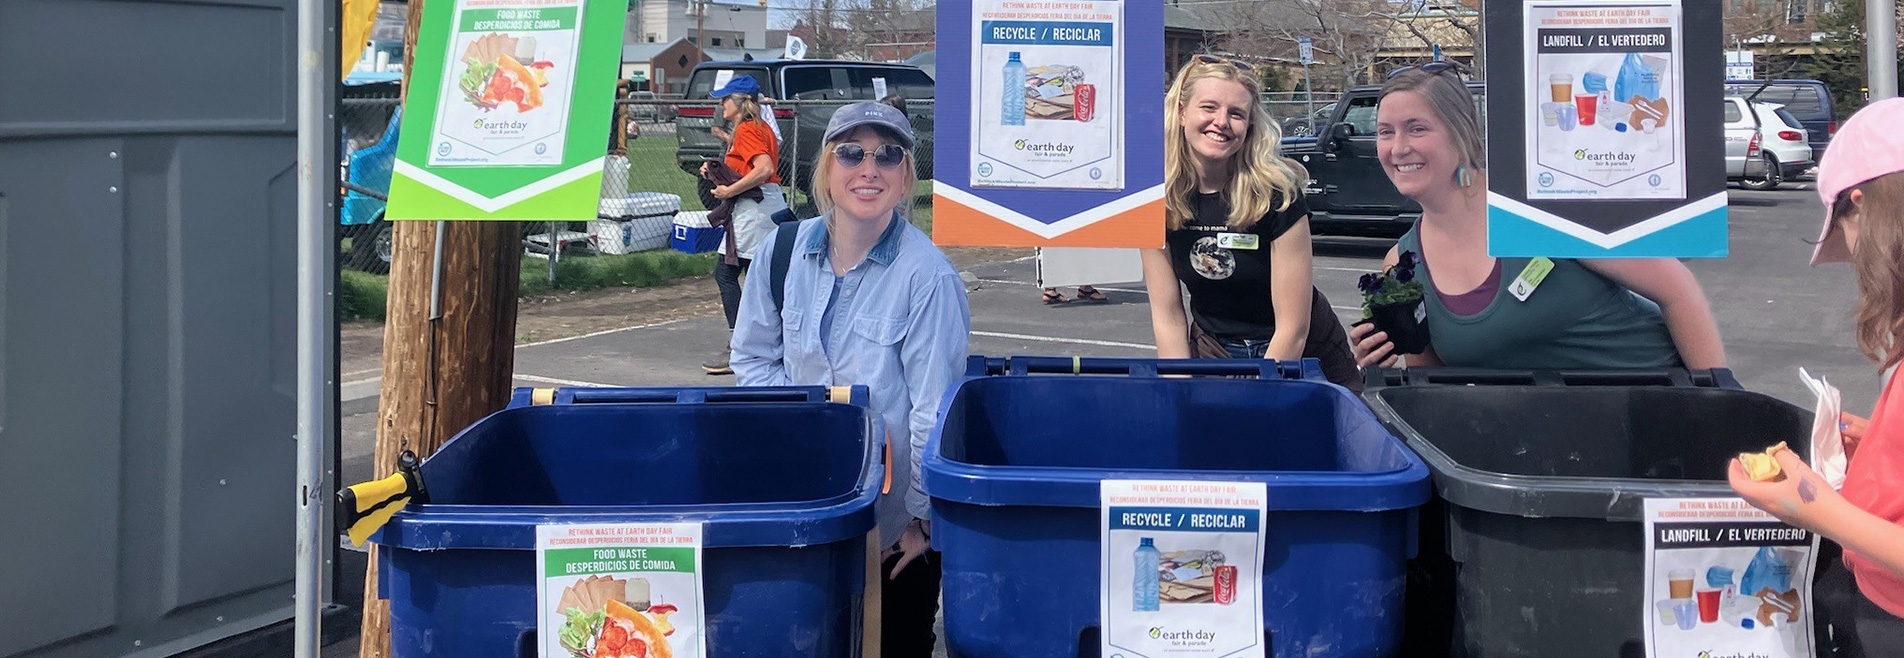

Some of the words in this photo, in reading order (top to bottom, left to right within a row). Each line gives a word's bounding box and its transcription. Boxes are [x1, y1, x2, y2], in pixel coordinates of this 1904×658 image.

[497, 10, 515, 19] FOOD
[516, 10, 541, 19] WASTE
[474, 20, 523, 30] DESPERDICIOS
[523, 20, 533, 29] DE
[534, 19, 560, 29] COMIDA
[993, 27, 1036, 40] RECYCLE
[1041, 28, 1048, 40] /
[1053, 28, 1101, 41] RECICLAR
[1543, 35, 1583, 47] LANDFILL
[1587, 35, 1594, 47] /
[1598, 35, 1610, 46] EL
[1611, 34, 1666, 46] VERTEDERO
[484, 120, 510, 129] earth
[510, 120, 528, 131] day
[1026, 142, 1055, 151] earth
[1056, 142, 1074, 154] day
[1587, 151, 1616, 161] earth
[1617, 151, 1636, 163] day
[1132, 484, 1158, 492] RETHINK
[1159, 484, 1179, 492] WASTE
[1189, 485, 1209, 493] EARTH
[1210, 485, 1221, 493] DAY
[1679, 501, 1706, 509] RETHINK
[1707, 501, 1729, 509] WASTE
[1731, 501, 1739, 509] AT
[1122, 512, 1172, 527] RECYCLE
[1177, 513, 1185, 527] /
[1190, 514, 1246, 528] RECICLAR
[568, 528, 594, 536] RETHINK
[595, 528, 615, 536] WASTE
[616, 527, 624, 535] AT
[625, 527, 645, 535] EARTH
[646, 527, 658, 535] DAY
[659, 527, 673, 535] FAIR
[1661, 529, 1710, 543] LANDFILL
[1715, 528, 1724, 542] /
[1728, 528, 1741, 541] EL
[1744, 528, 1806, 541] VERTEDERO
[593, 549, 616, 560] FOOD
[617, 549, 647, 559] WASTE
[565, 561, 627, 574] DESPERDICIOS
[629, 561, 641, 570] DE
[642, 560, 676, 571] COMIDA
[1162, 629, 1193, 640] earth
[1195, 629, 1215, 643] day
